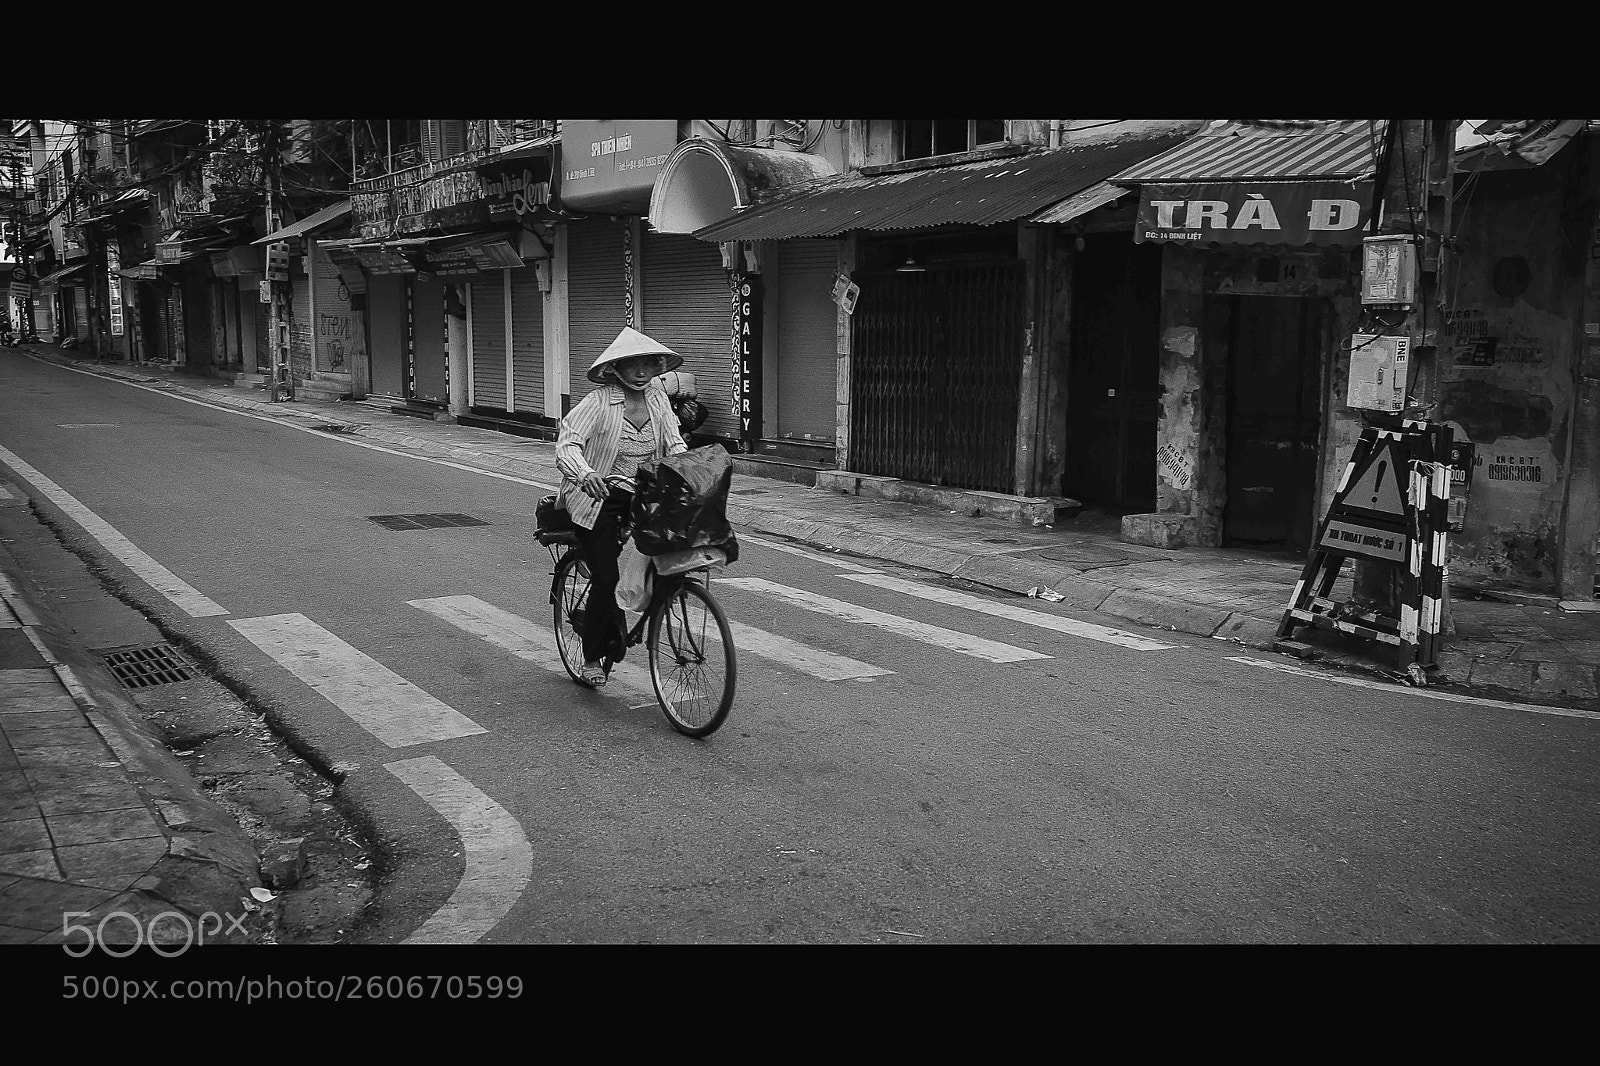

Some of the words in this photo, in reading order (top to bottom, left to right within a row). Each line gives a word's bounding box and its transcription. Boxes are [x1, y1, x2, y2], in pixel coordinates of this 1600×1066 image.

[1150, 193, 1282, 230] TRÀ
[1284, 264, 1296, 280] 14
[1396, 341, 1407, 362] BNE
[742, 302, 751, 432] GALLERY
